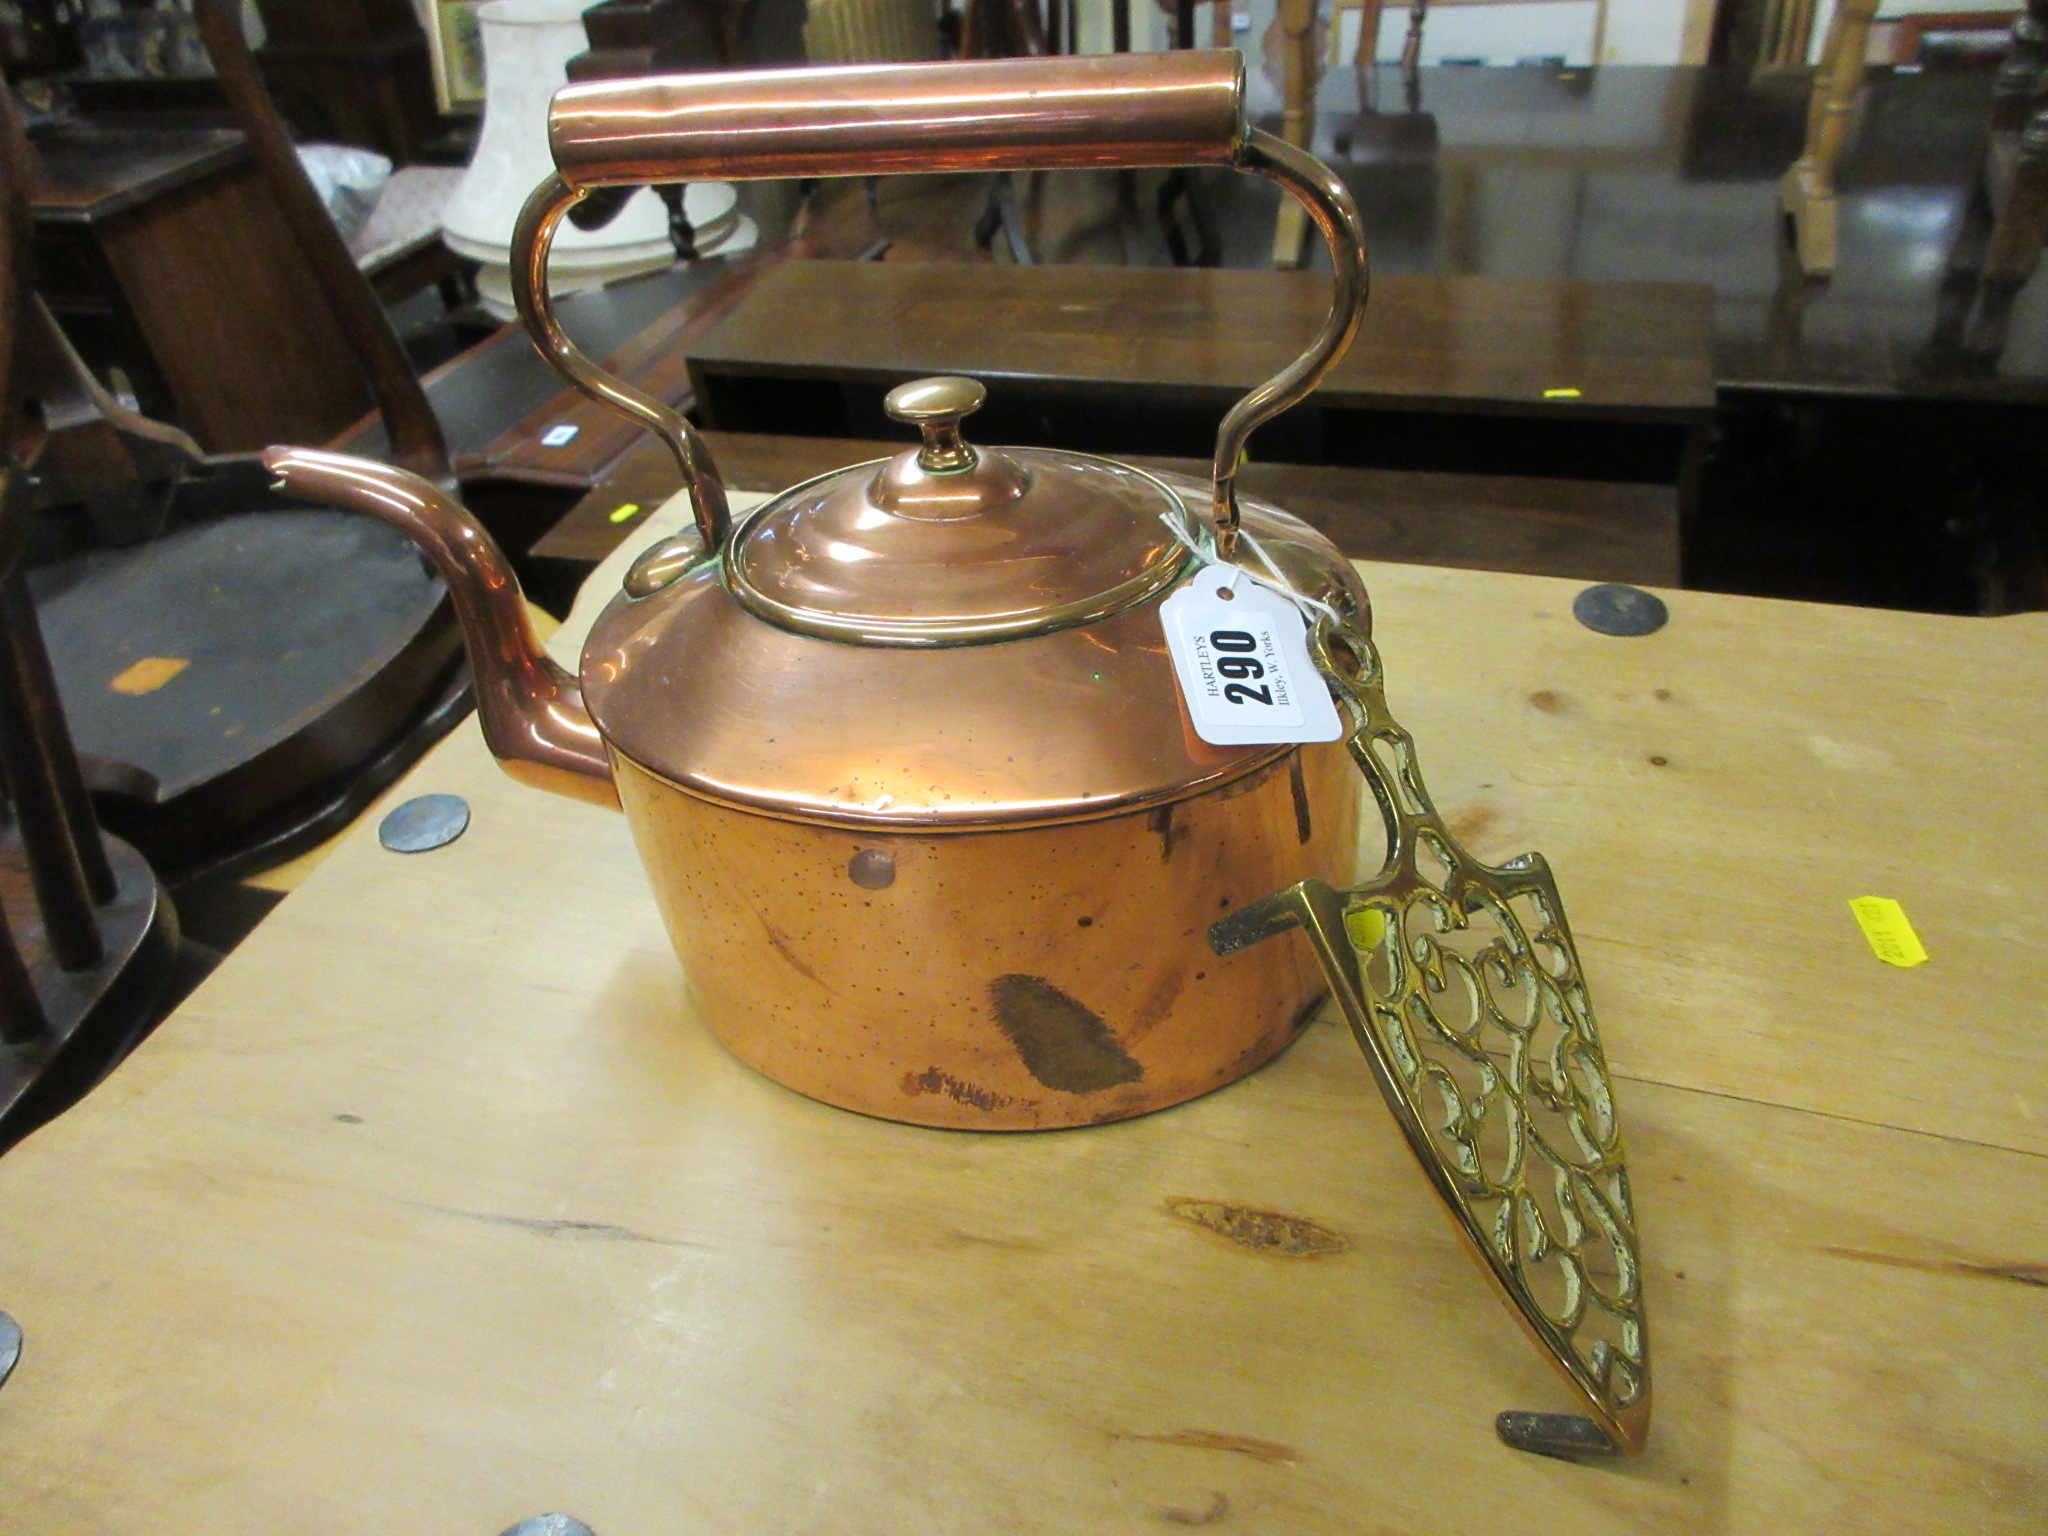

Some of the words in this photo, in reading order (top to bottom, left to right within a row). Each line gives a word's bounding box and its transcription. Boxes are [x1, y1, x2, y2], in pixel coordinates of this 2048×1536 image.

[1260, 630, 1275, 658] Yorks
[1194, 636, 1220, 697] HARTLEYS
[1210, 630, 1274, 706] 290
[1266, 660, 1279, 674] W.
